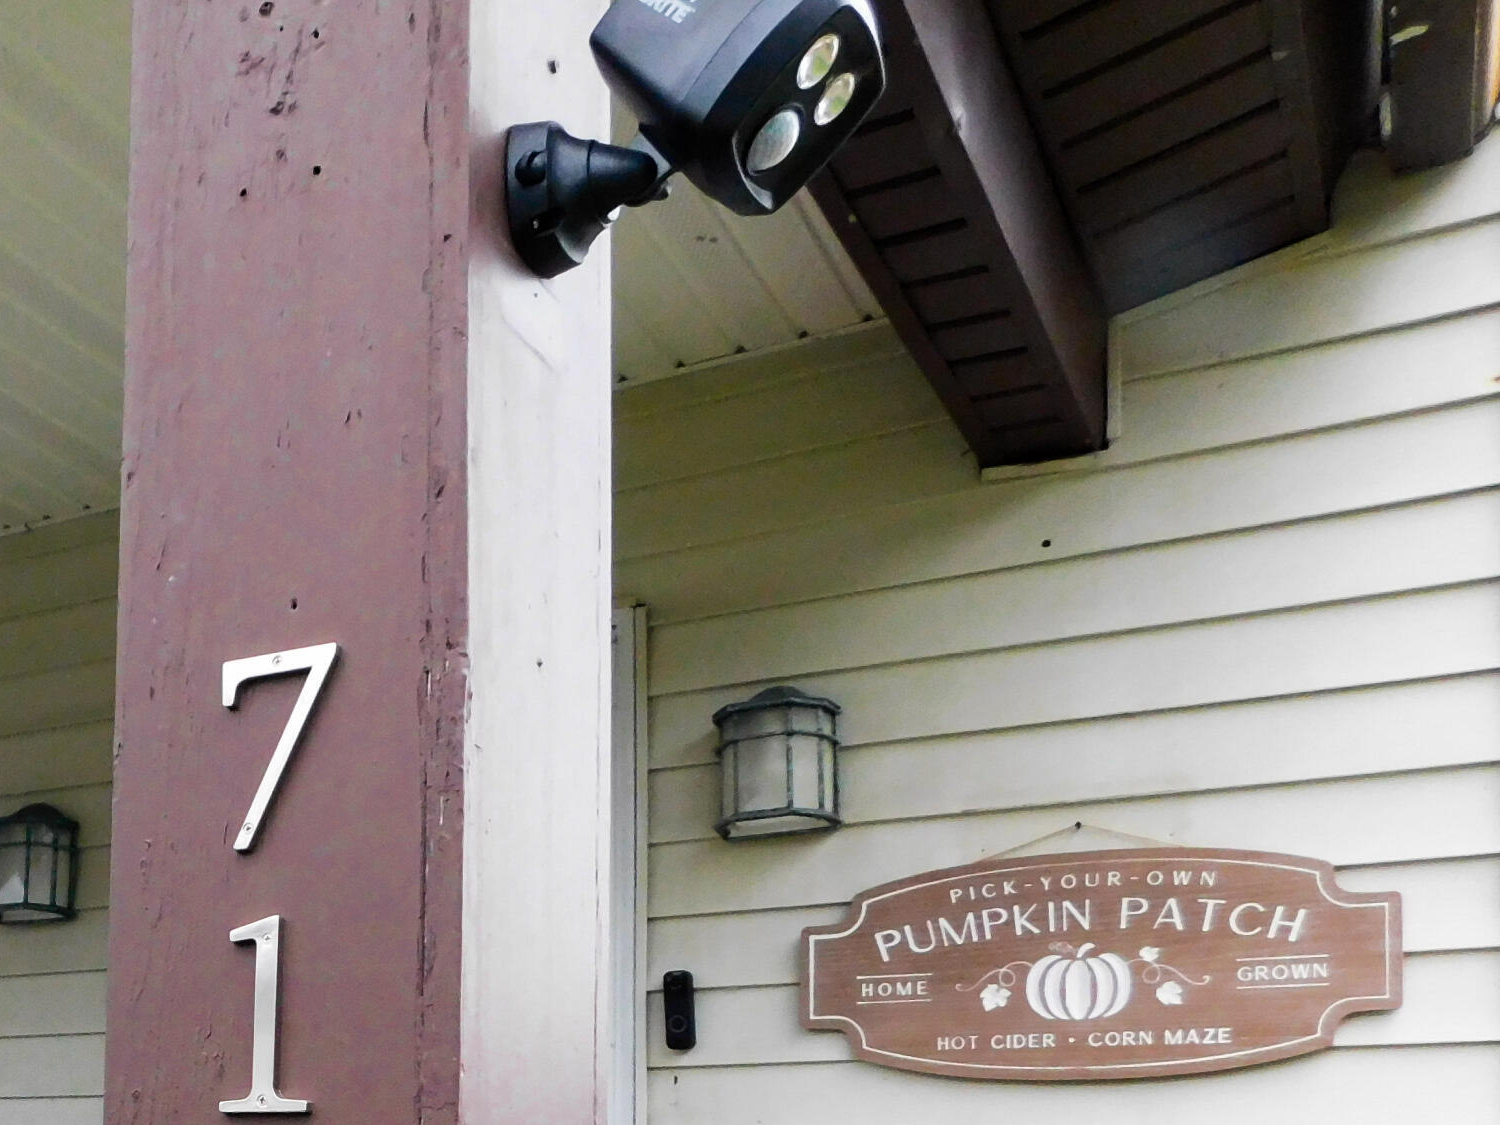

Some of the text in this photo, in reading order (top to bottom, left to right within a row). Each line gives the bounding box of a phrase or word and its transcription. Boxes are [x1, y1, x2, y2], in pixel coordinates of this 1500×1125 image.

[639, 0, 696, 23] RITE
[874, 897, 1308, 962] PUMPKIN PATCH
[1237, 962, 1329, 982] GROWN
[861, 980, 930, 997] HOME
[937, 1027, 1233, 1051] HOT CIDER CORN MAZE
